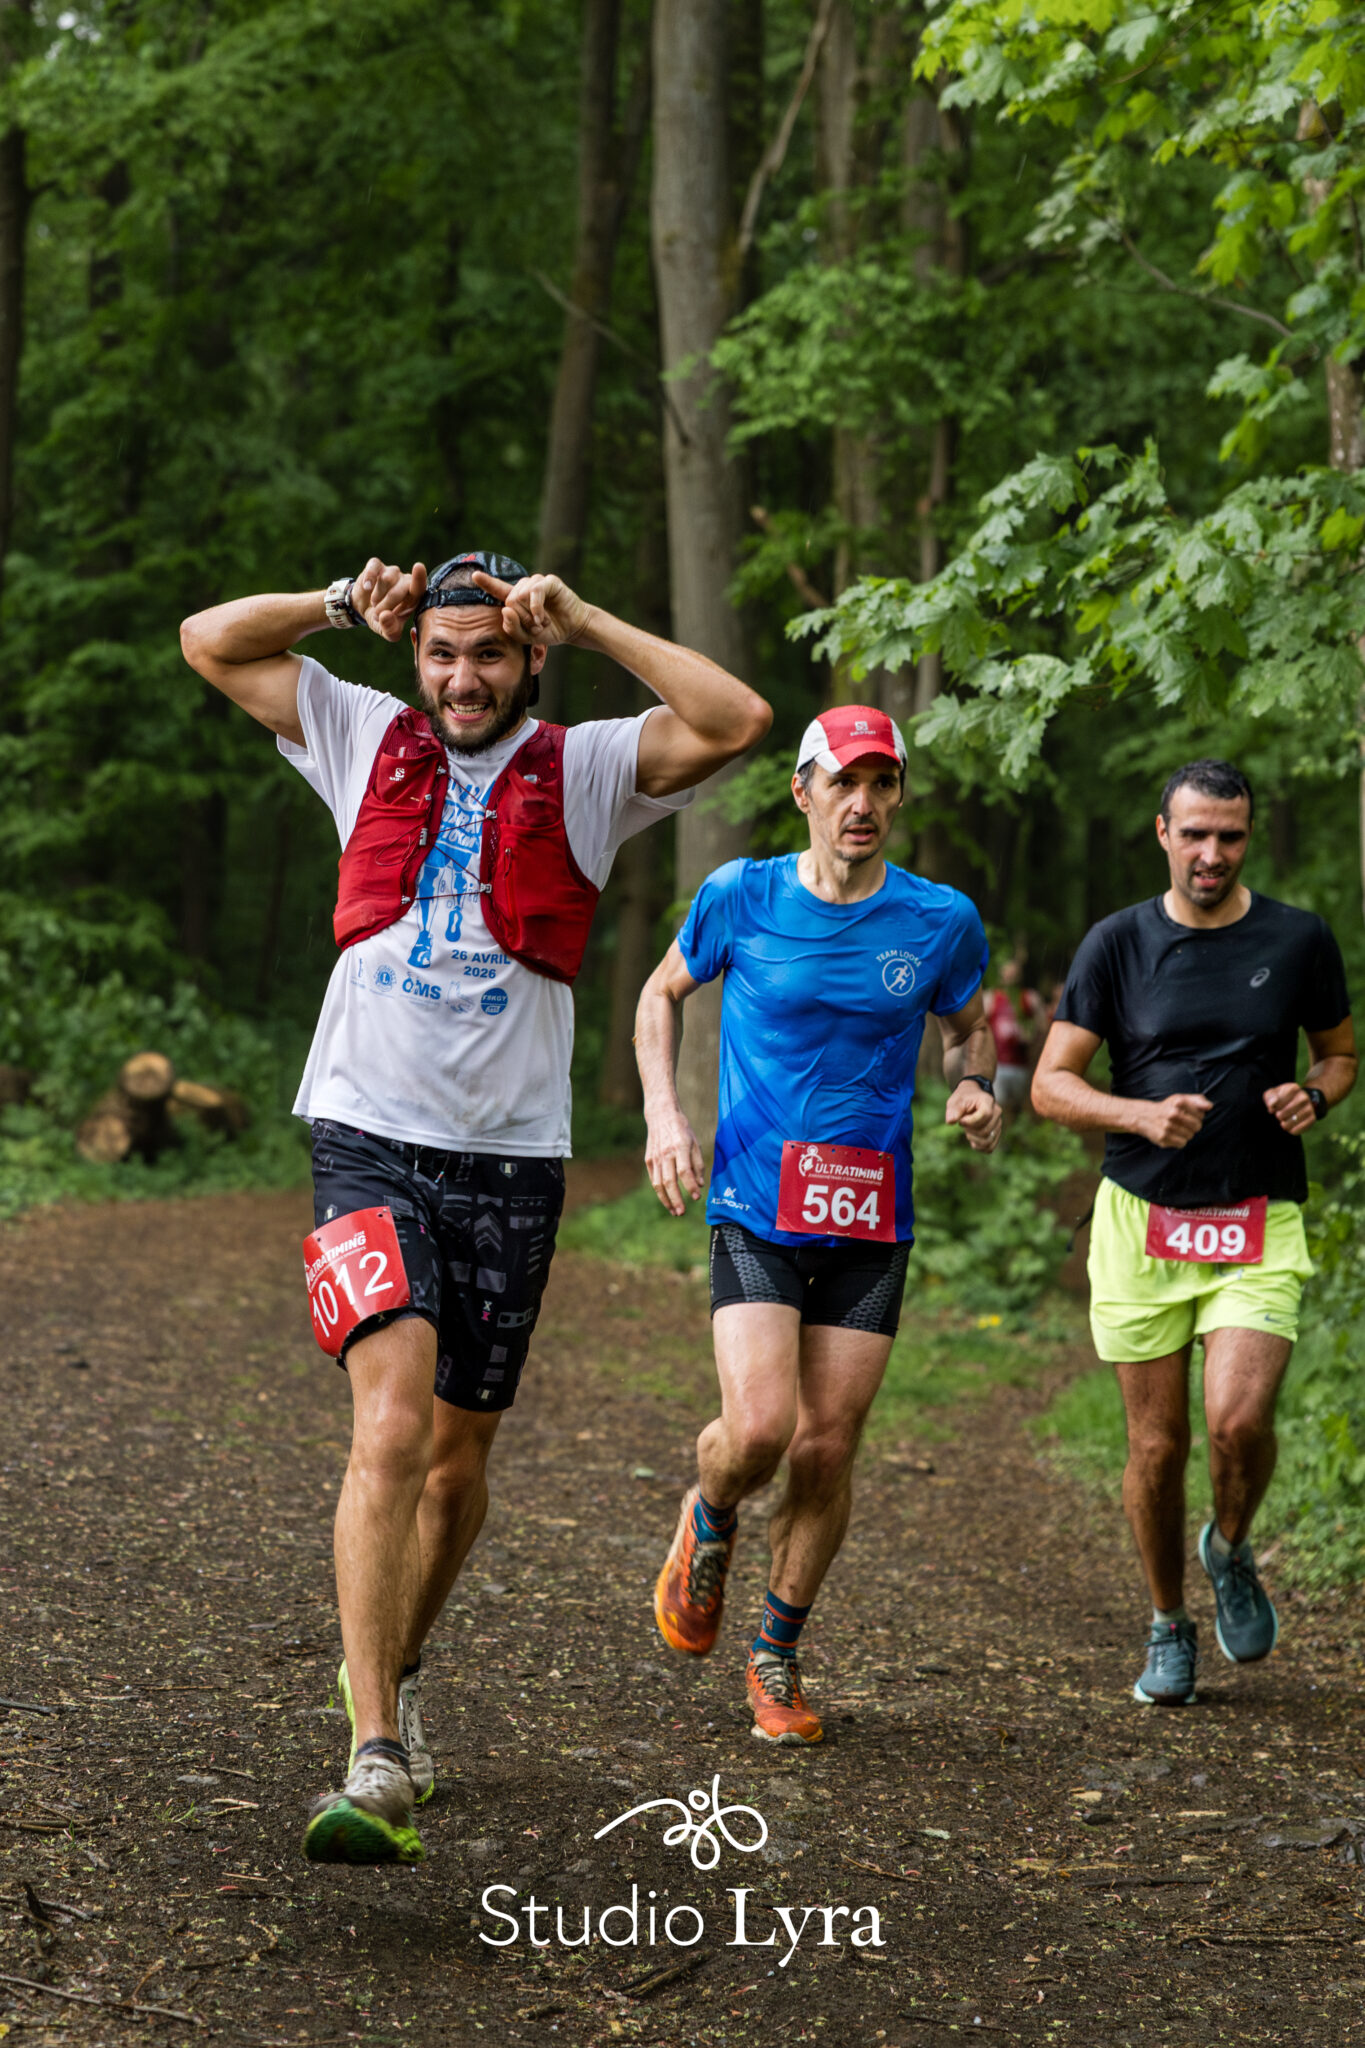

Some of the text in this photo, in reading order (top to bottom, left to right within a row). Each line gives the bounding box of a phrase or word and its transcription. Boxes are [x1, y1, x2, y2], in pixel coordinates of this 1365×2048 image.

[451, 949, 511, 965] 26 AVRIL
[875, 949, 898, 963] TEAM
[463, 966, 497, 979] 2026
[814, 1162, 884, 1181] ULTRATIMING
[801, 1184, 881, 1230] 564
[1165, 1221, 1246, 1256] 409
[312, 1250, 394, 1338] 1012
